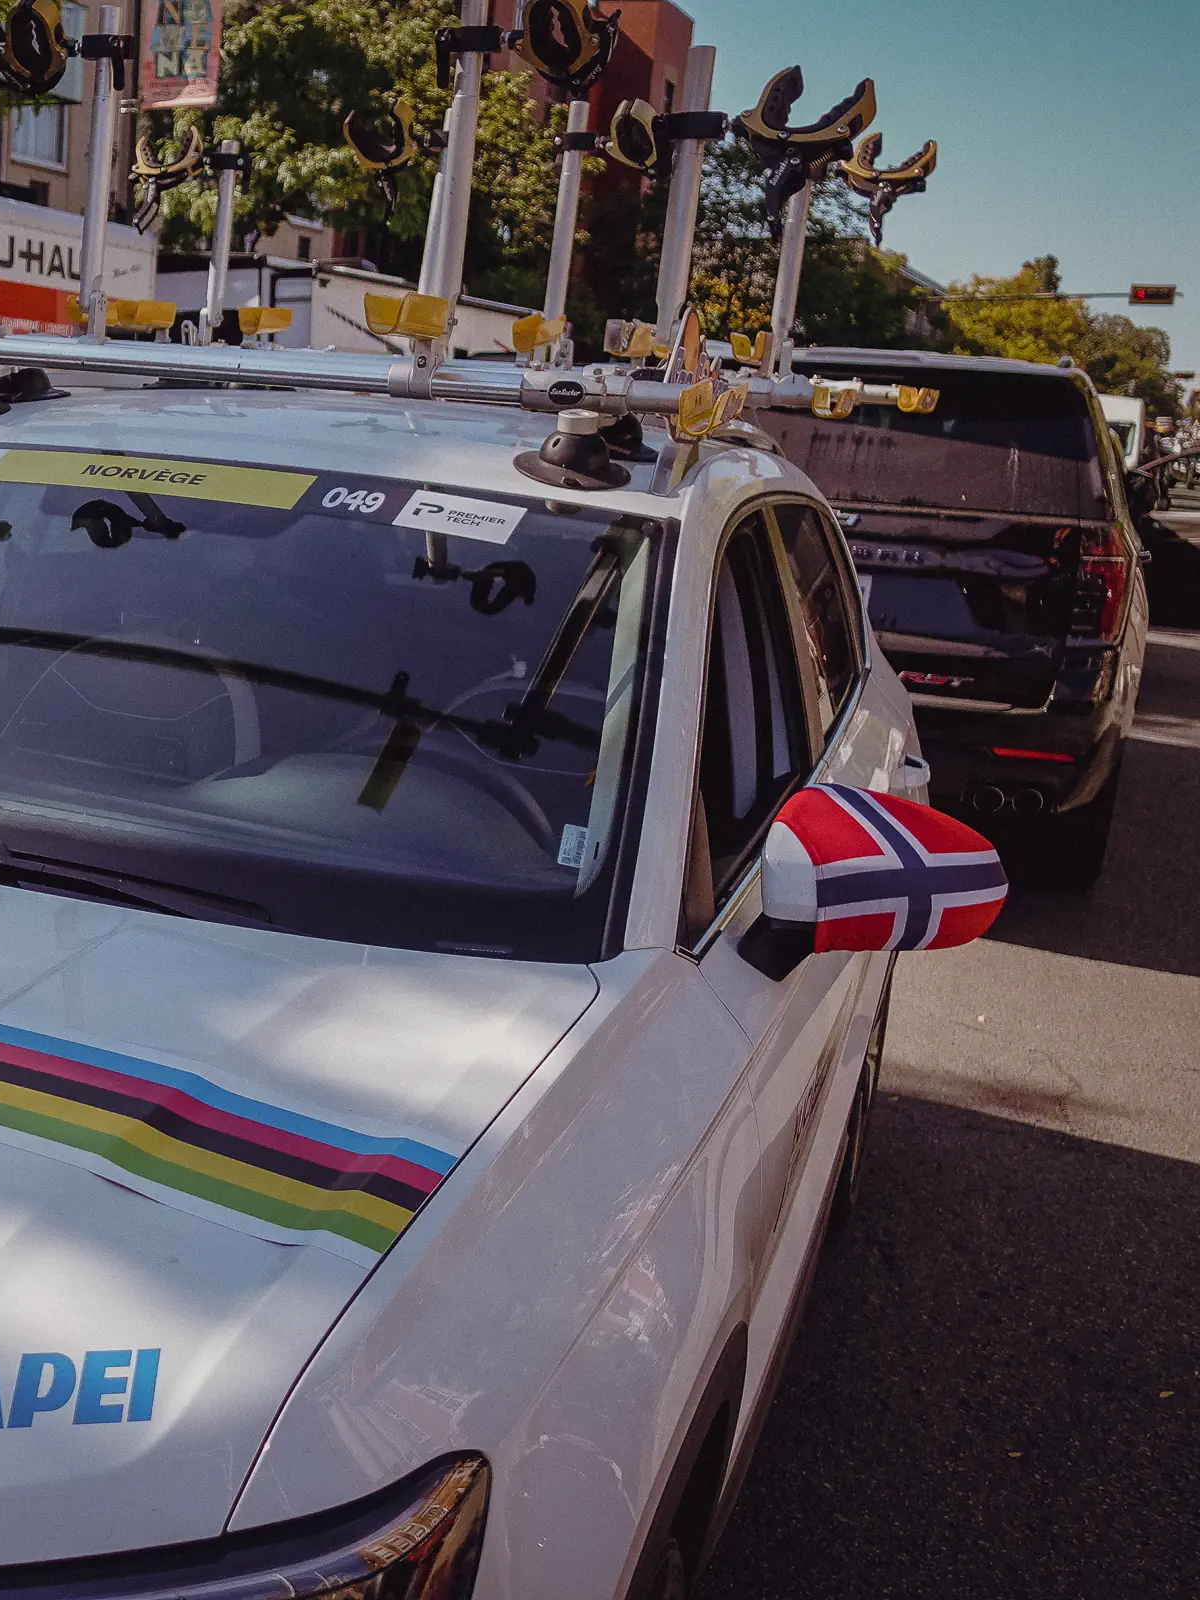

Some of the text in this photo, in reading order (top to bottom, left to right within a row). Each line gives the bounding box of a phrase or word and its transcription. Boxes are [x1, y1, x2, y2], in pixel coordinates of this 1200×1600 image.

[81, 464, 207, 486] NORVÈGE
[321, 487, 386, 513] 049
[446, 516, 482, 527] TECH
[448, 509, 506, 525] PREMIER
